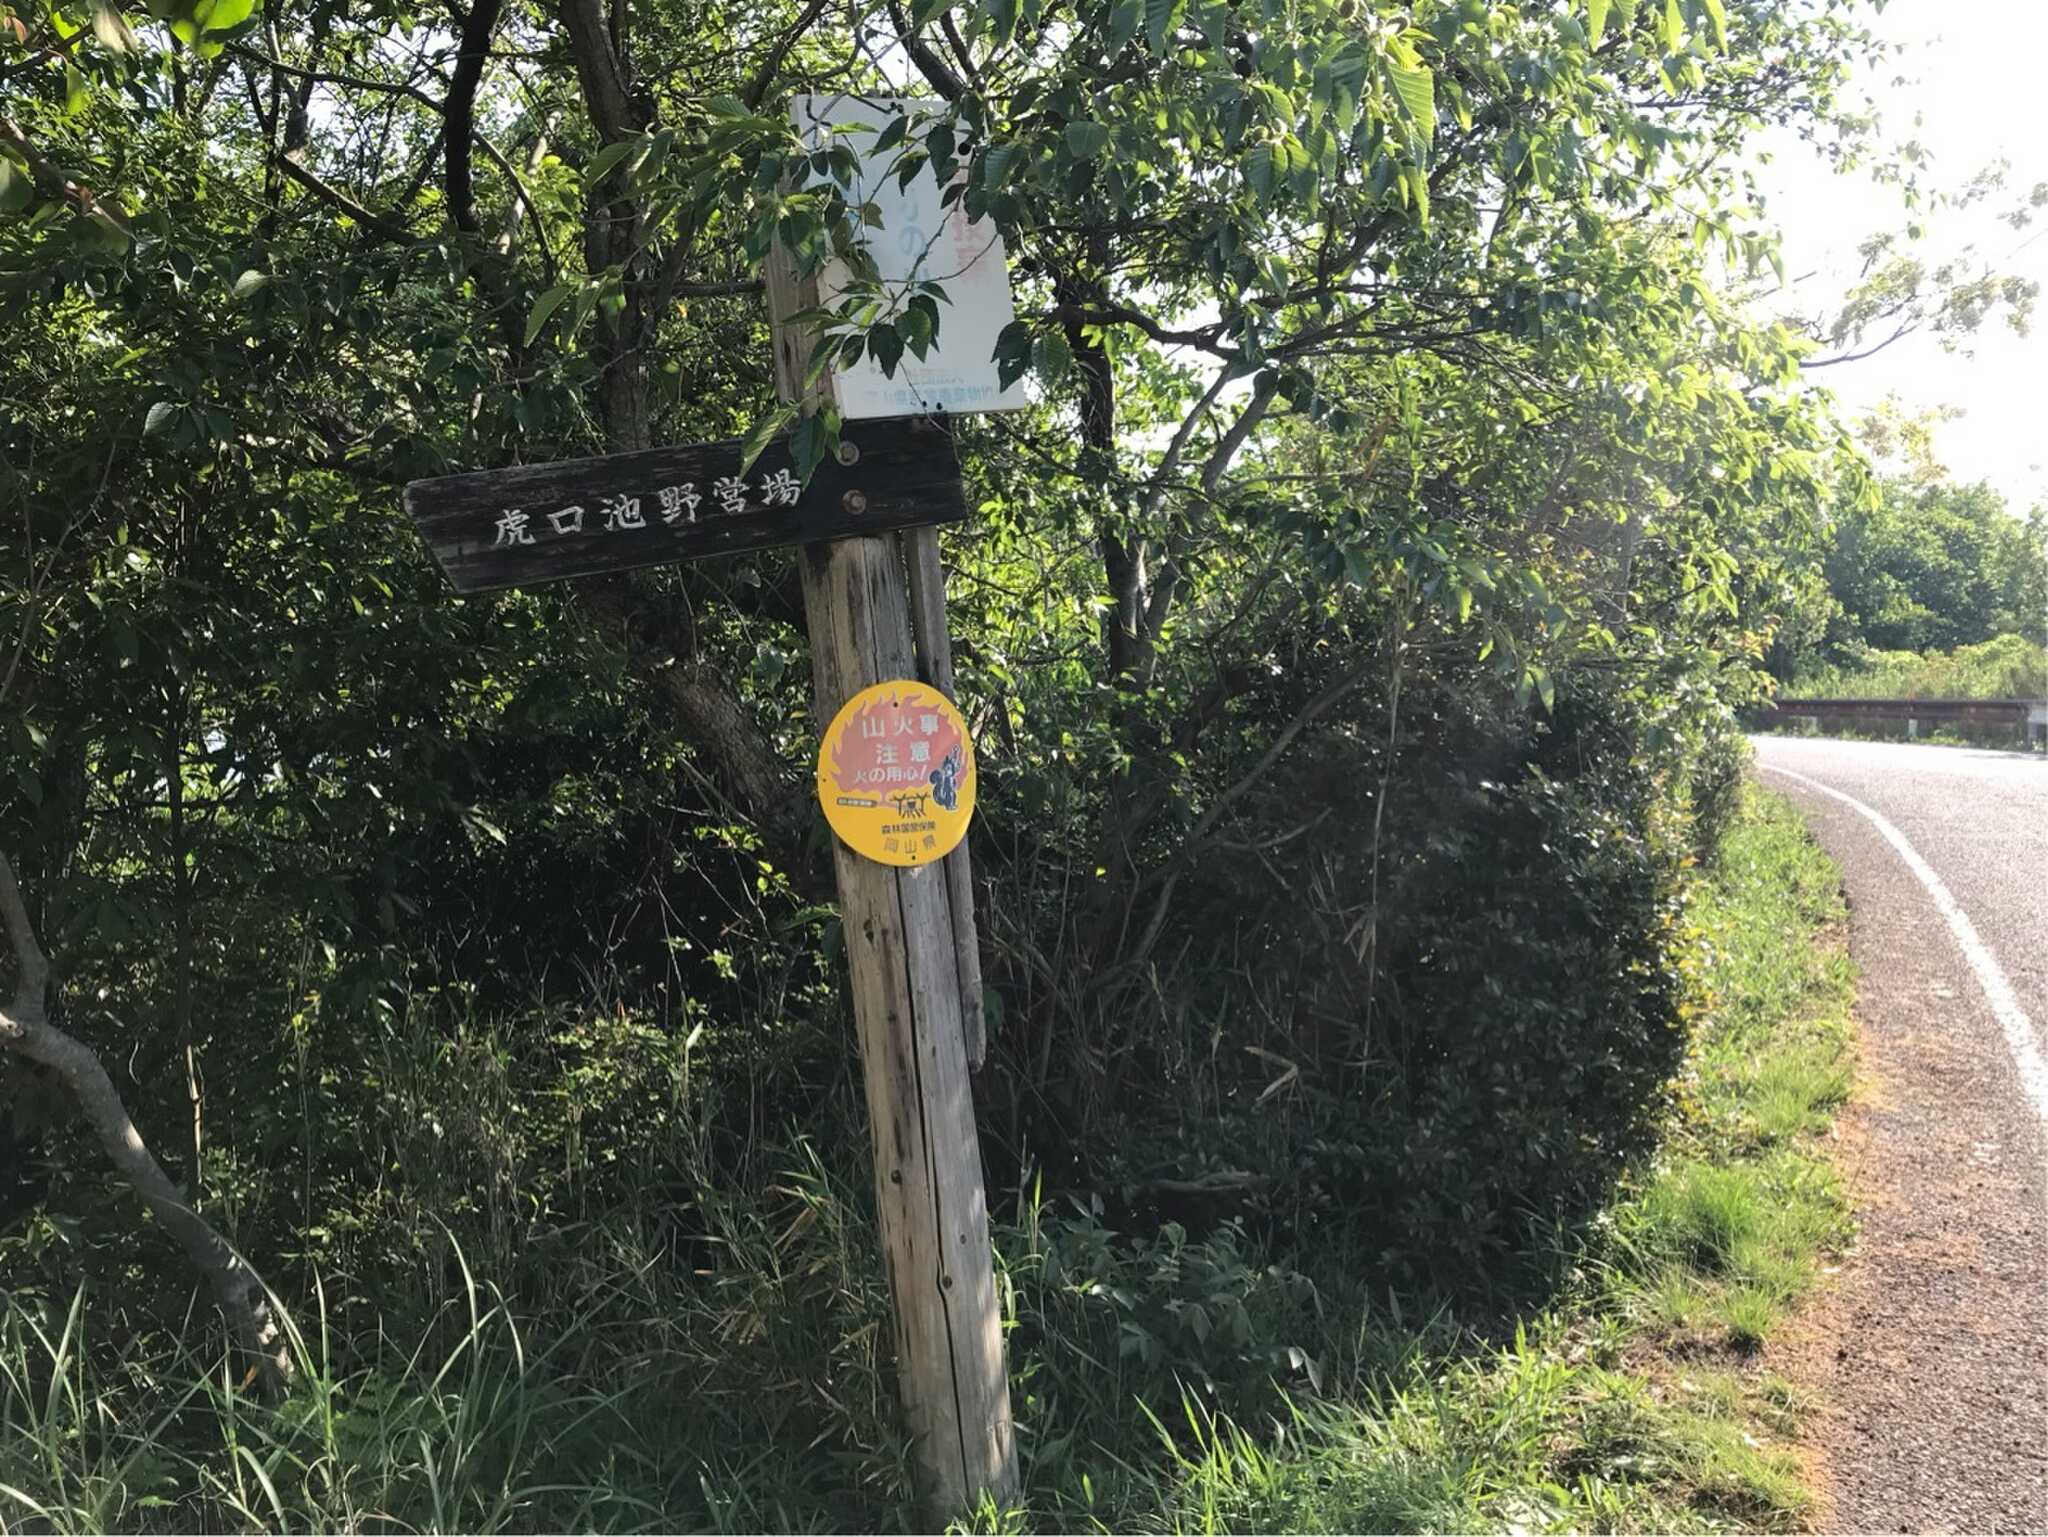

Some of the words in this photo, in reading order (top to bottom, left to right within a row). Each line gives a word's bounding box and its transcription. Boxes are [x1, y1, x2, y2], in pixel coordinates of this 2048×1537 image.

[493, 467, 801, 547] 虎口池野営場
[862, 713, 939, 738] 山火事
[875, 740, 931, 765] 注意
[884, 834, 936, 854] 岡山県
